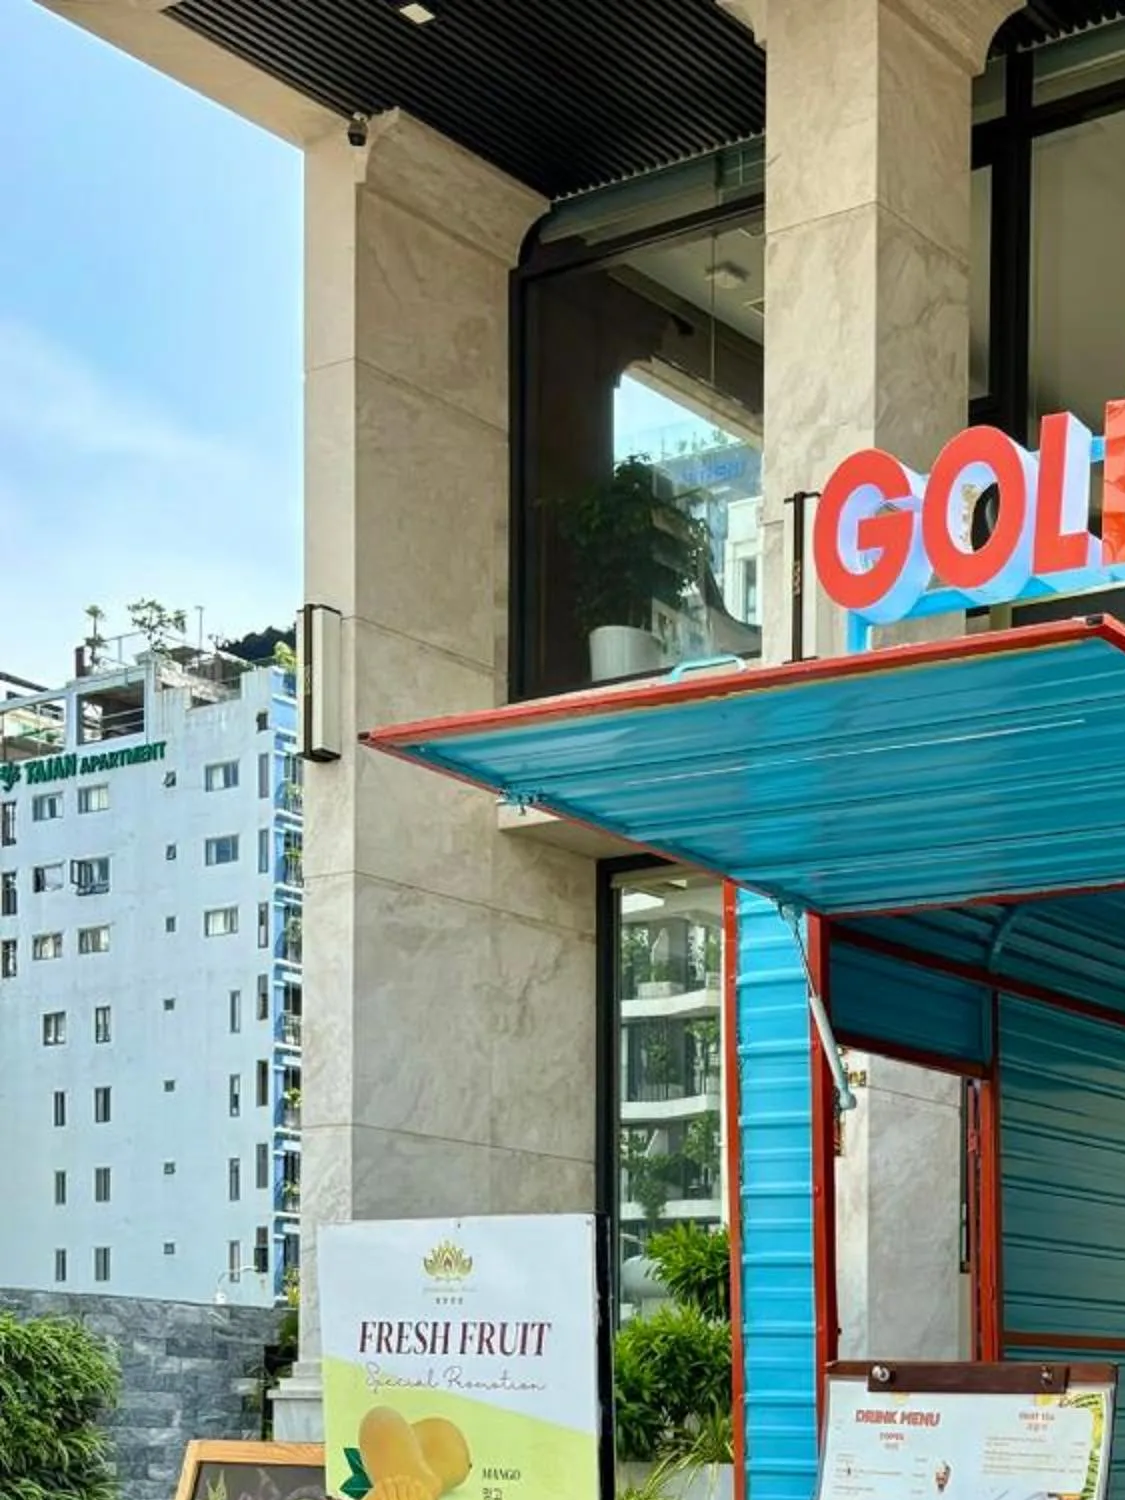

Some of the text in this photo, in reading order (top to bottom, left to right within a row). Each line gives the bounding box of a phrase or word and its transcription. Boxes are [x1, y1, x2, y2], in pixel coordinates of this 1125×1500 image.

[79, 740, 167, 775] APARTMENT
[359, 1321, 553, 1357] FRESH FRUIT
[364, 1361, 547, 1393] Special Promotion
[855, 1409, 941, 1427] DRINK MENU
